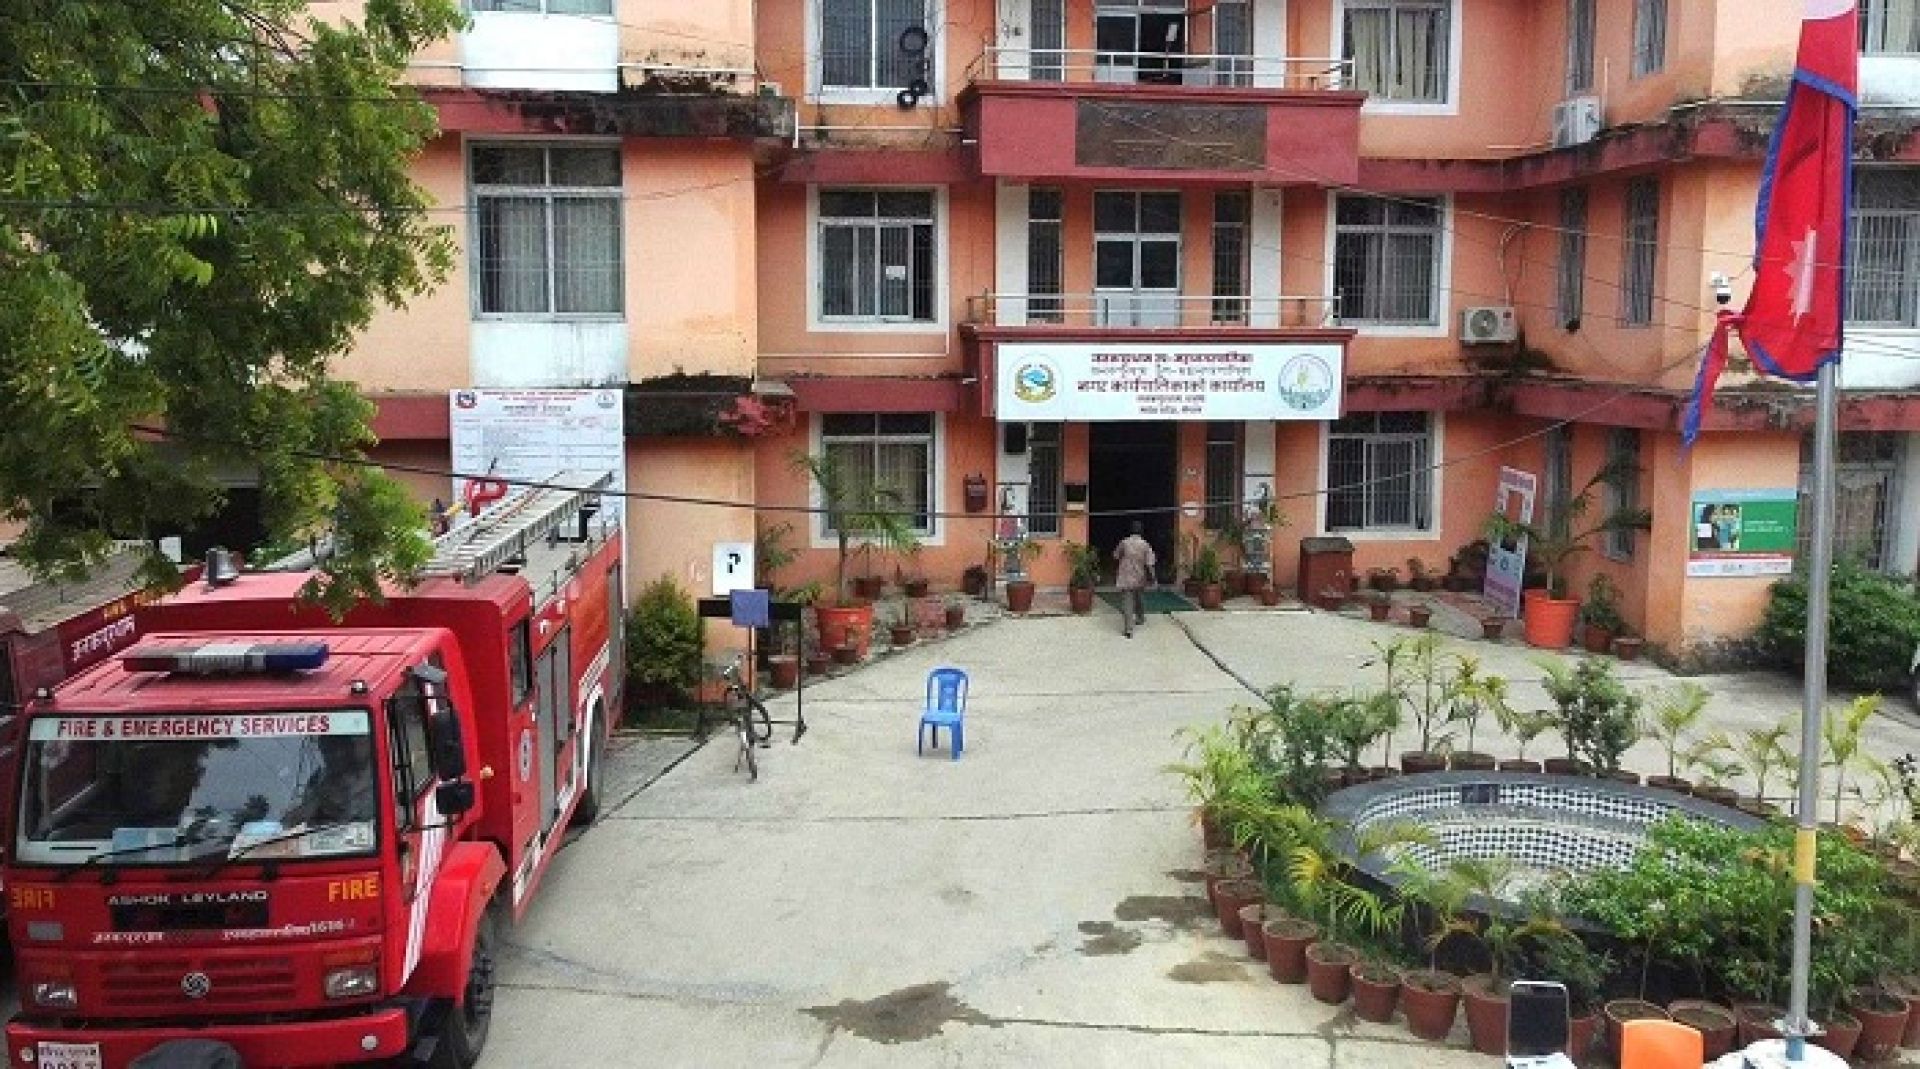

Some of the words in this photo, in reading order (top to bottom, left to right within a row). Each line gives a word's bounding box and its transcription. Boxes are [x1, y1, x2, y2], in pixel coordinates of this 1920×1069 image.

[57, 719, 97, 738] FIRE
[103, 719, 115, 737] &
[121, 717, 234, 737] EMERGENCY
[241, 715, 330, 735] SERVICES
[107, 893, 170, 905] ASHOK
[183, 889, 269, 903] LEYLAND
[328, 875, 380, 903] FIRE
